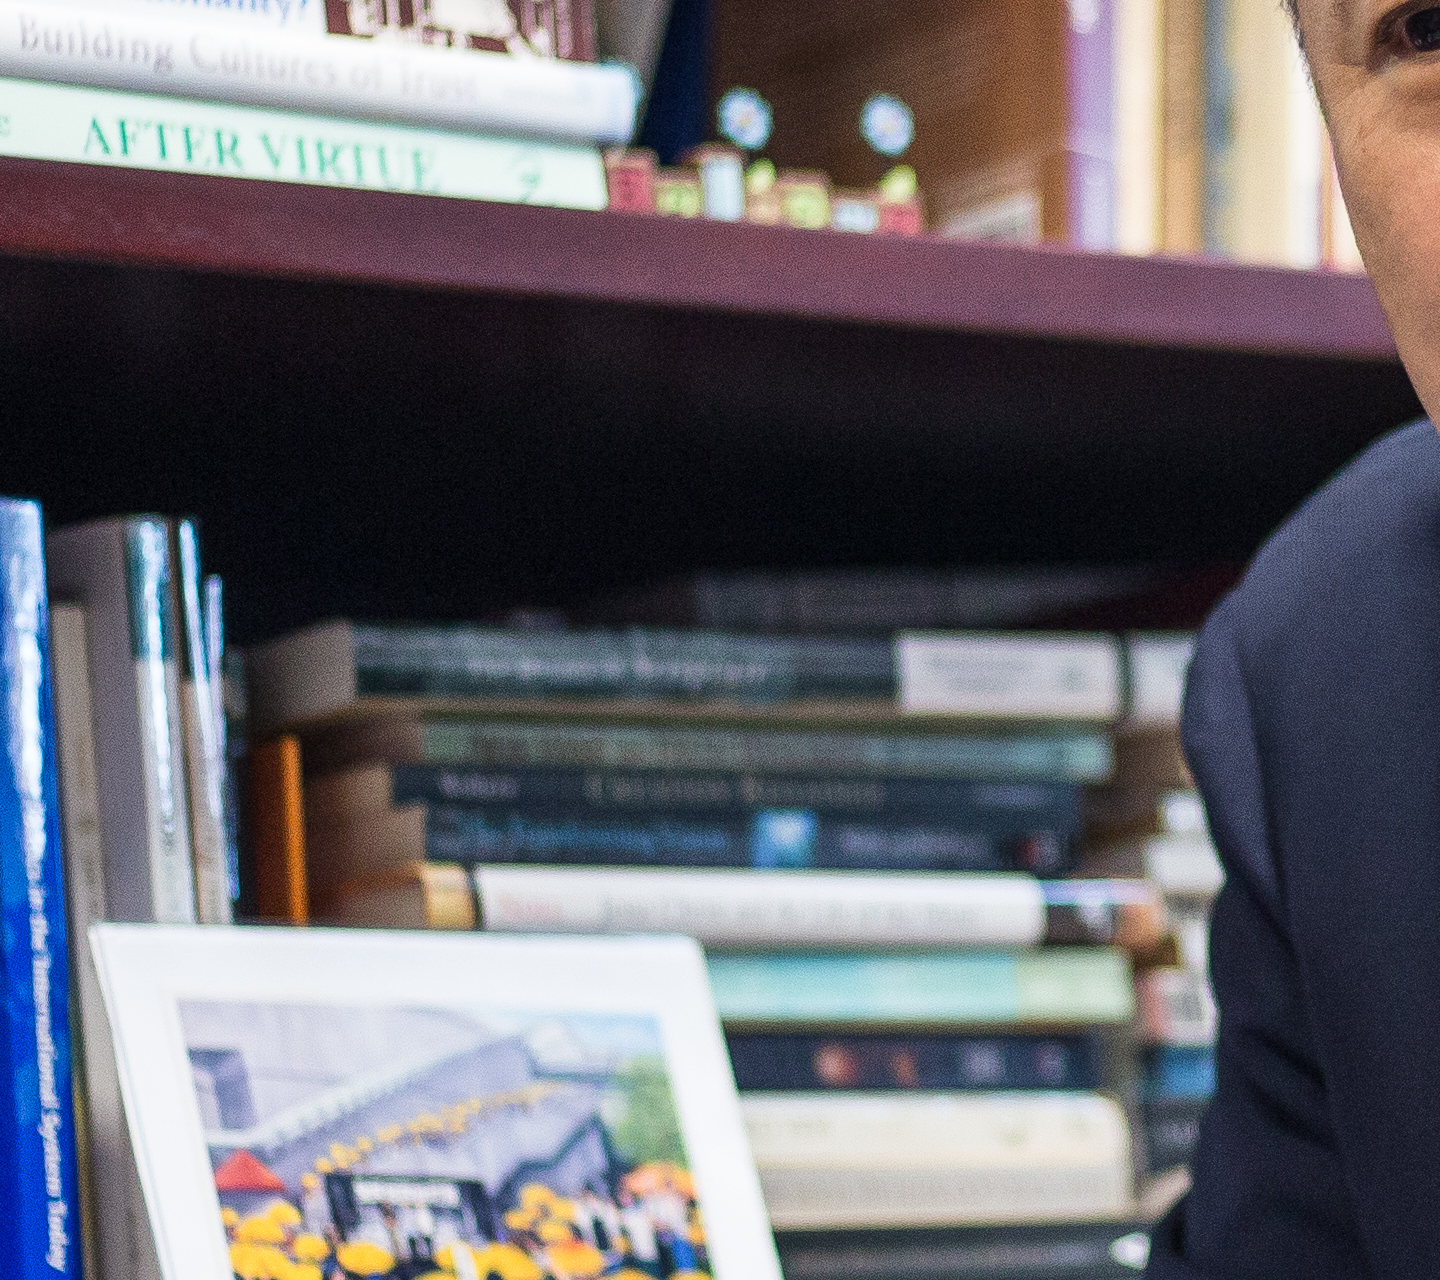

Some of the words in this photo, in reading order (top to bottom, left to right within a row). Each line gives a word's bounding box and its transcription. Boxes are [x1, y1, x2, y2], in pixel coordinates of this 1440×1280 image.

[21, 14, 173, 73] Building
[84, 116, 244, 170] AFTER
[259, 133, 443, 193] VIRTUE
